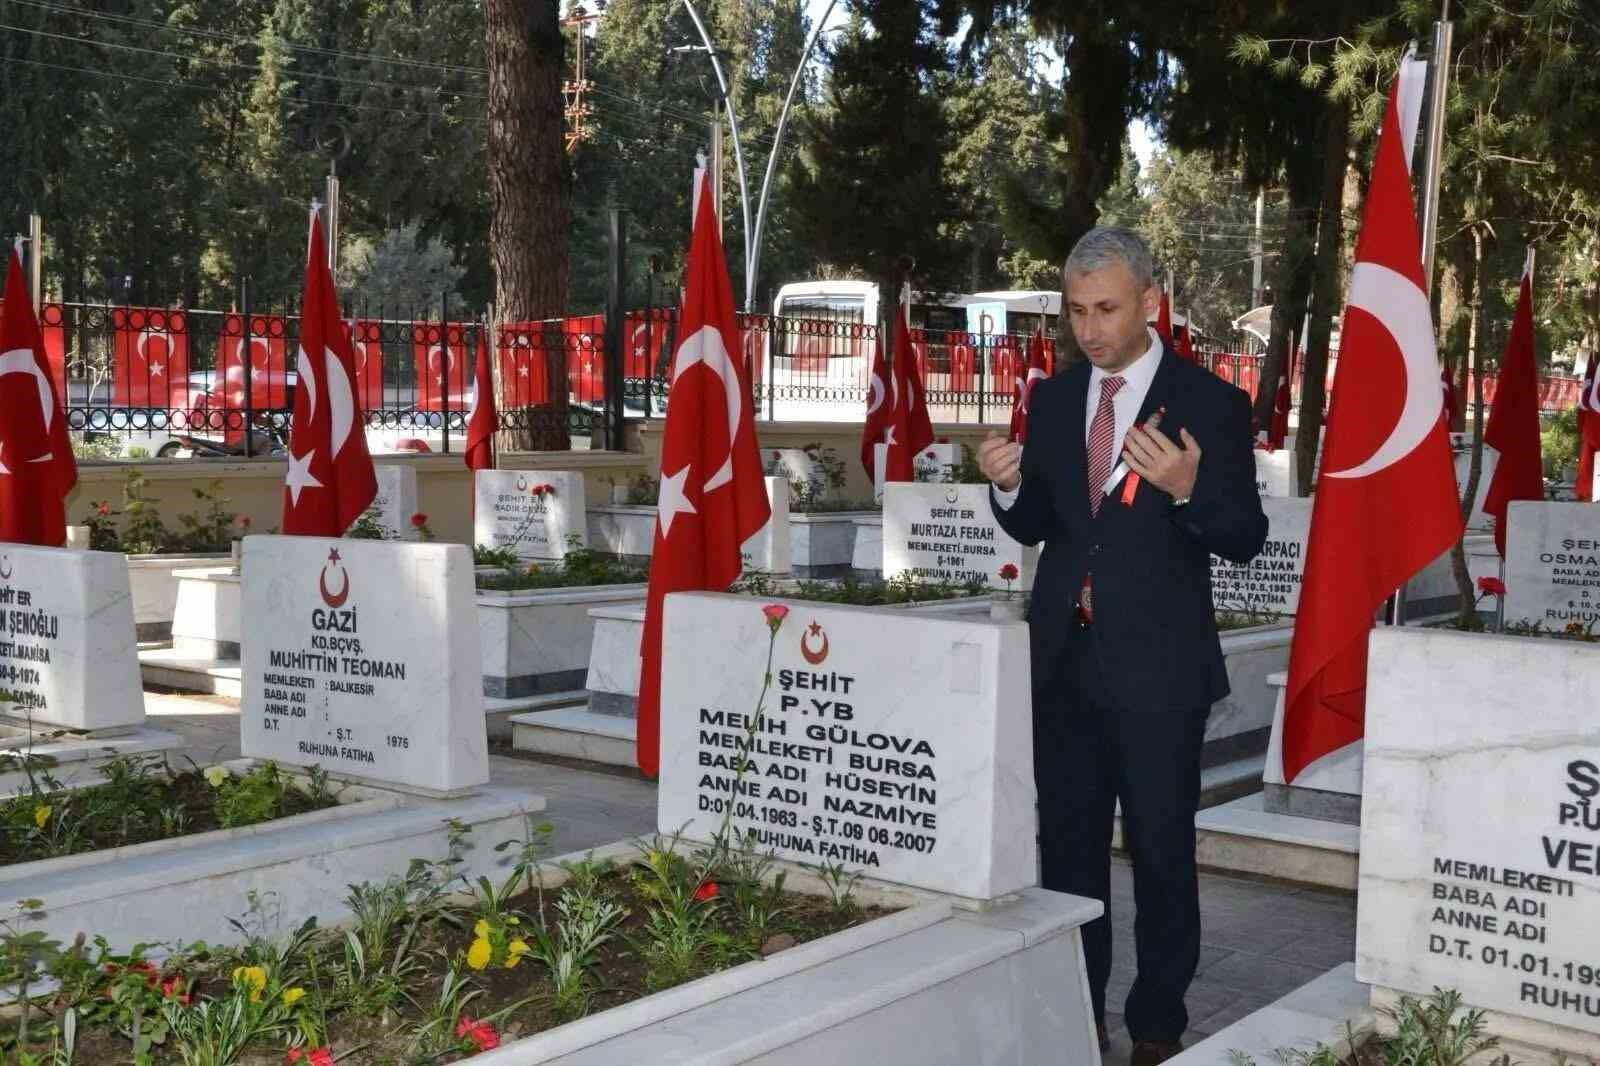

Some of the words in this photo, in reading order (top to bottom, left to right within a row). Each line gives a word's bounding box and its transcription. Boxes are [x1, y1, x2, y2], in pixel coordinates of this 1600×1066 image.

[930, 508, 958, 519] ŞEHİT
[960, 510, 974, 519] ER
[911, 523, 957, 538] MURTAZA
[960, 525, 994, 541] FERAH
[1540, 553, 1598, 566] OSMA
[17, 590, 31, 607] ER
[9, 608, 58, 639] ŞENOĞLU
[312, 606, 357, 633] GAZİ
[270, 649, 338, 673] MUHİTTİN
[342, 657, 406, 681] TEOMAN
[778, 668, 855, 694] ŞEHİT
[264, 688, 288, 702] BABA
[290, 692, 306, 704] ADI
[780, 695, 854, 721] P.YB
[264, 703, 289, 716] ANNE
[291, 706, 306, 718] ADI
[264, 718, 280, 731] D.T.
[299, 740, 338, 757] RUHUNA
[806, 723, 936, 758] GÜLOVA
[699, 751, 760, 775] BABA
[765, 763, 807, 783] ADI
[825, 772, 936, 805] HÜSEYİN
[849, 753, 936, 782] BURSA
[698, 774, 760, 798] ANNE
[767, 786, 807, 806] ADI
[824, 795, 936, 829] NAZMİYE
[819, 841, 880, 867] FATİHA
[1432, 882, 1497, 910] BABA
[1504, 896, 1546, 919] ADI
[1431, 907, 1497, 934] ANNE
[1504, 921, 1546, 943] ADI
[1429, 934, 1473, 960] D.T.
